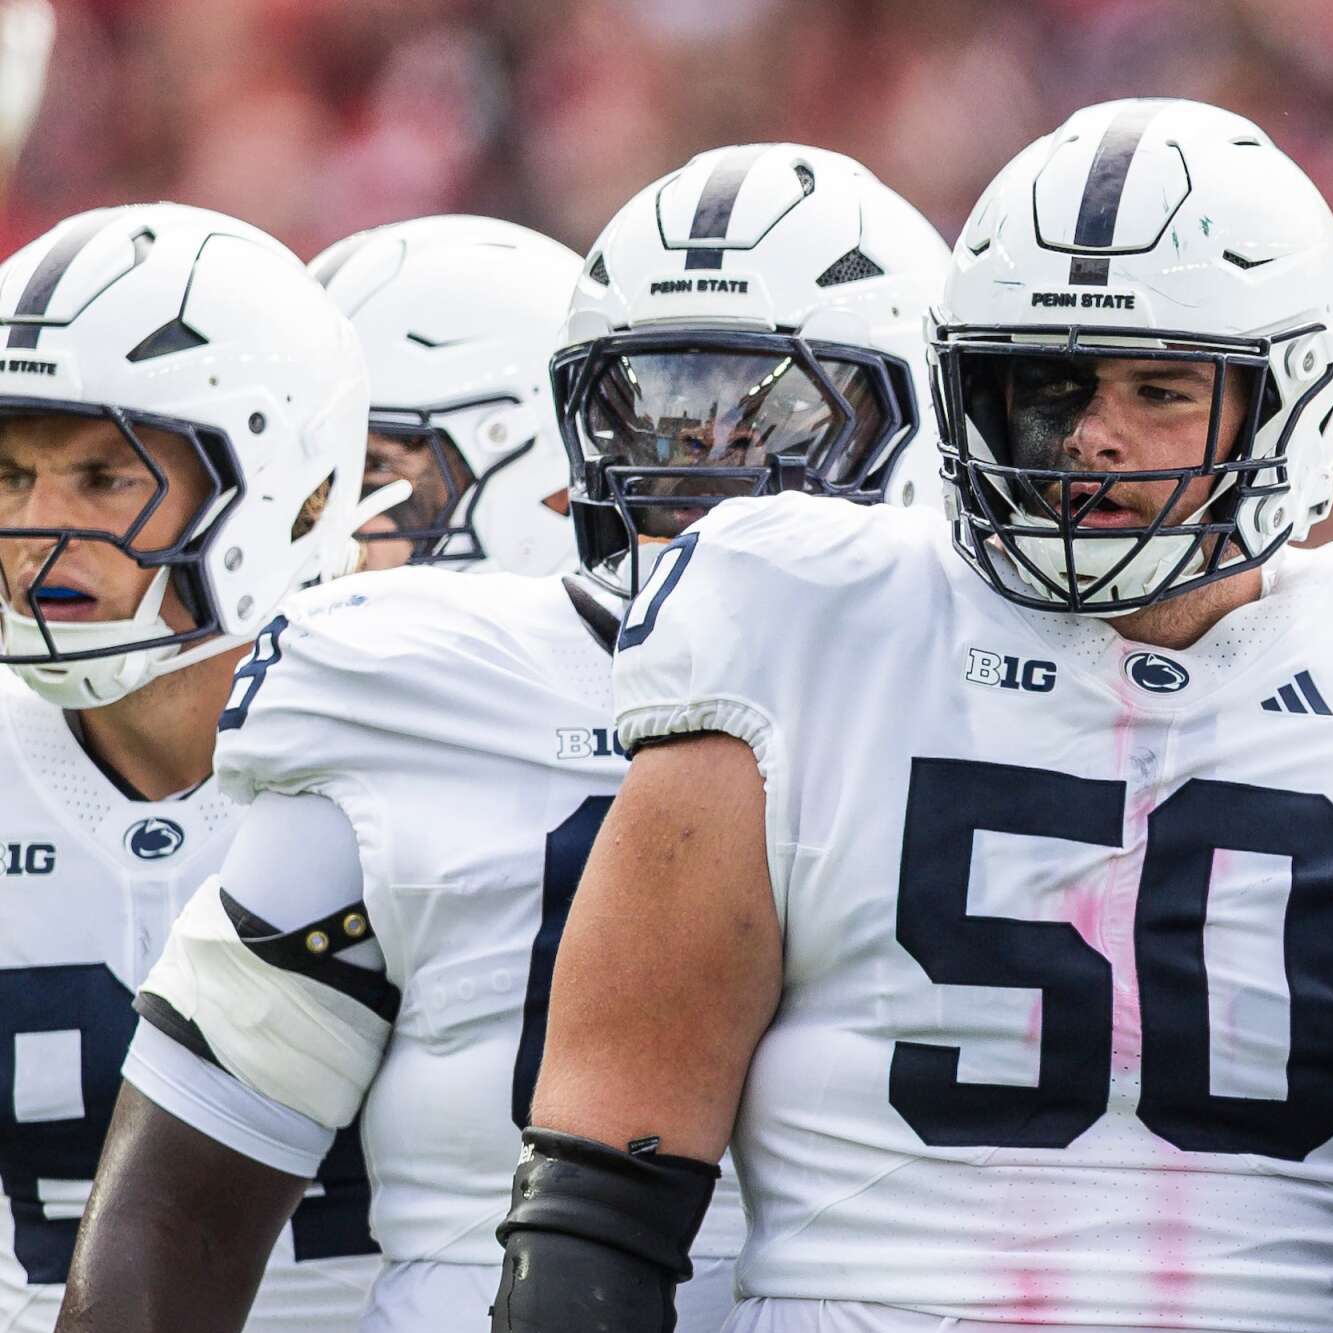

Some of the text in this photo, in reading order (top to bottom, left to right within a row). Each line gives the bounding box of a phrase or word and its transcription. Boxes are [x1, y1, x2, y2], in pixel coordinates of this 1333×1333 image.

[650, 279, 749, 296] PENN STATE
[1031, 292, 1135, 310] PENN STATE
